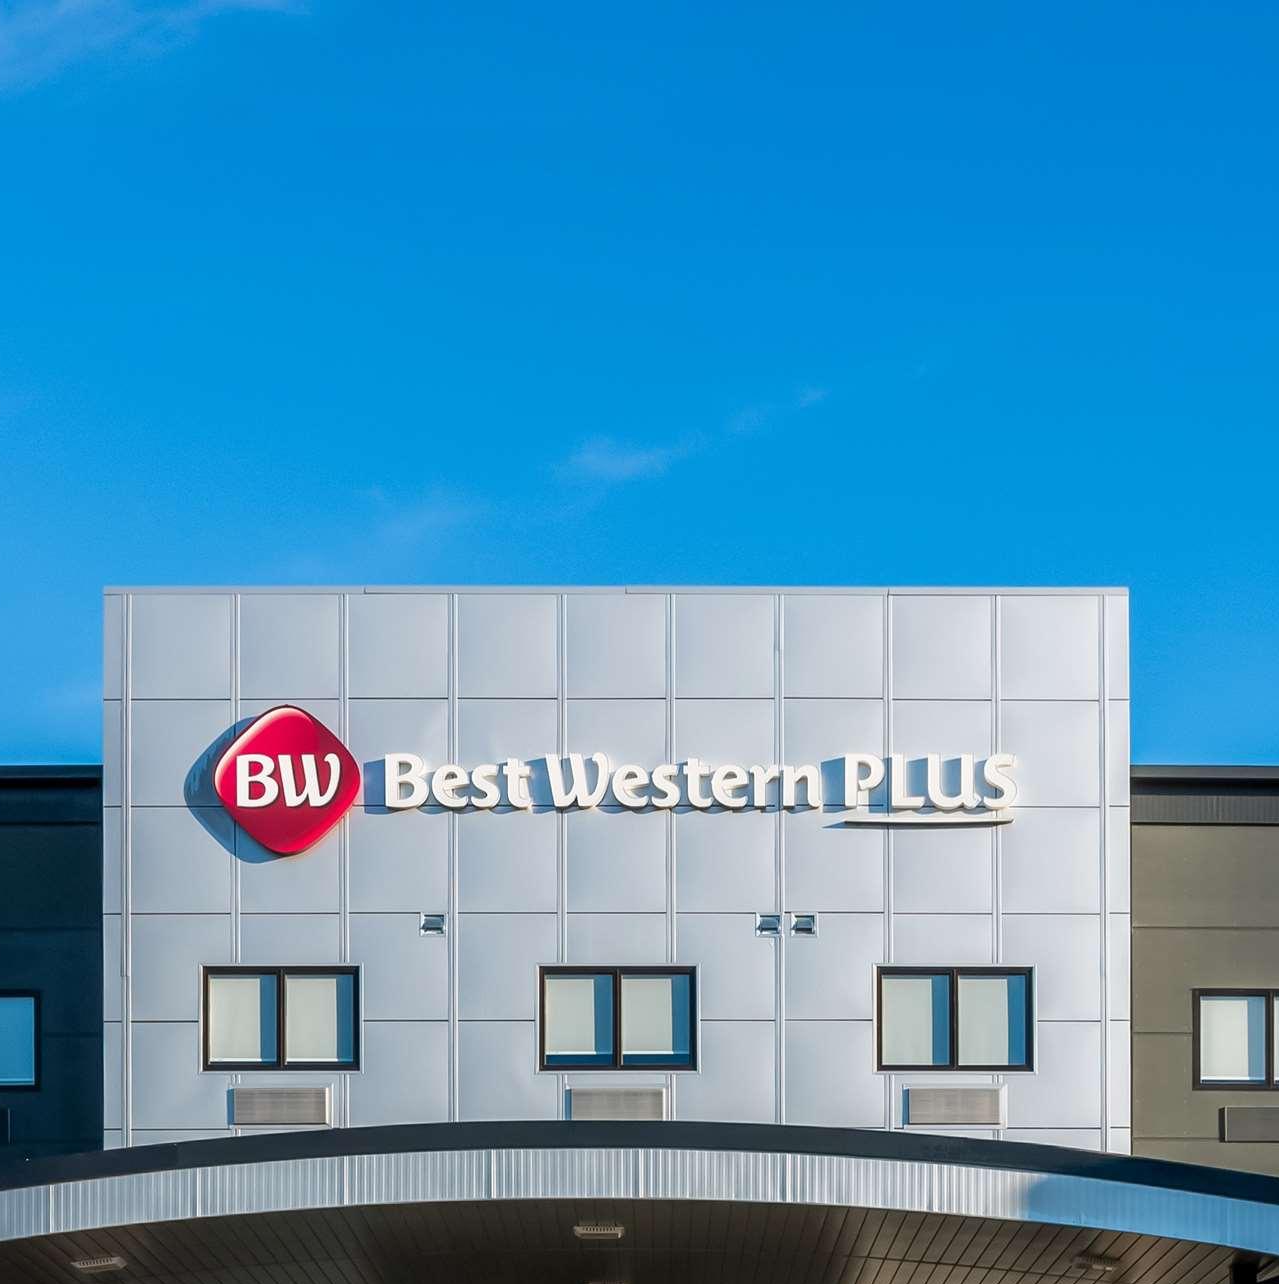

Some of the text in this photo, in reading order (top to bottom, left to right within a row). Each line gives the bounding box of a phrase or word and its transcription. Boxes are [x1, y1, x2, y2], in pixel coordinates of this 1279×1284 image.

[236, 753, 341, 808] BW
[384, 752, 1018, 809] Best Western PLUS
